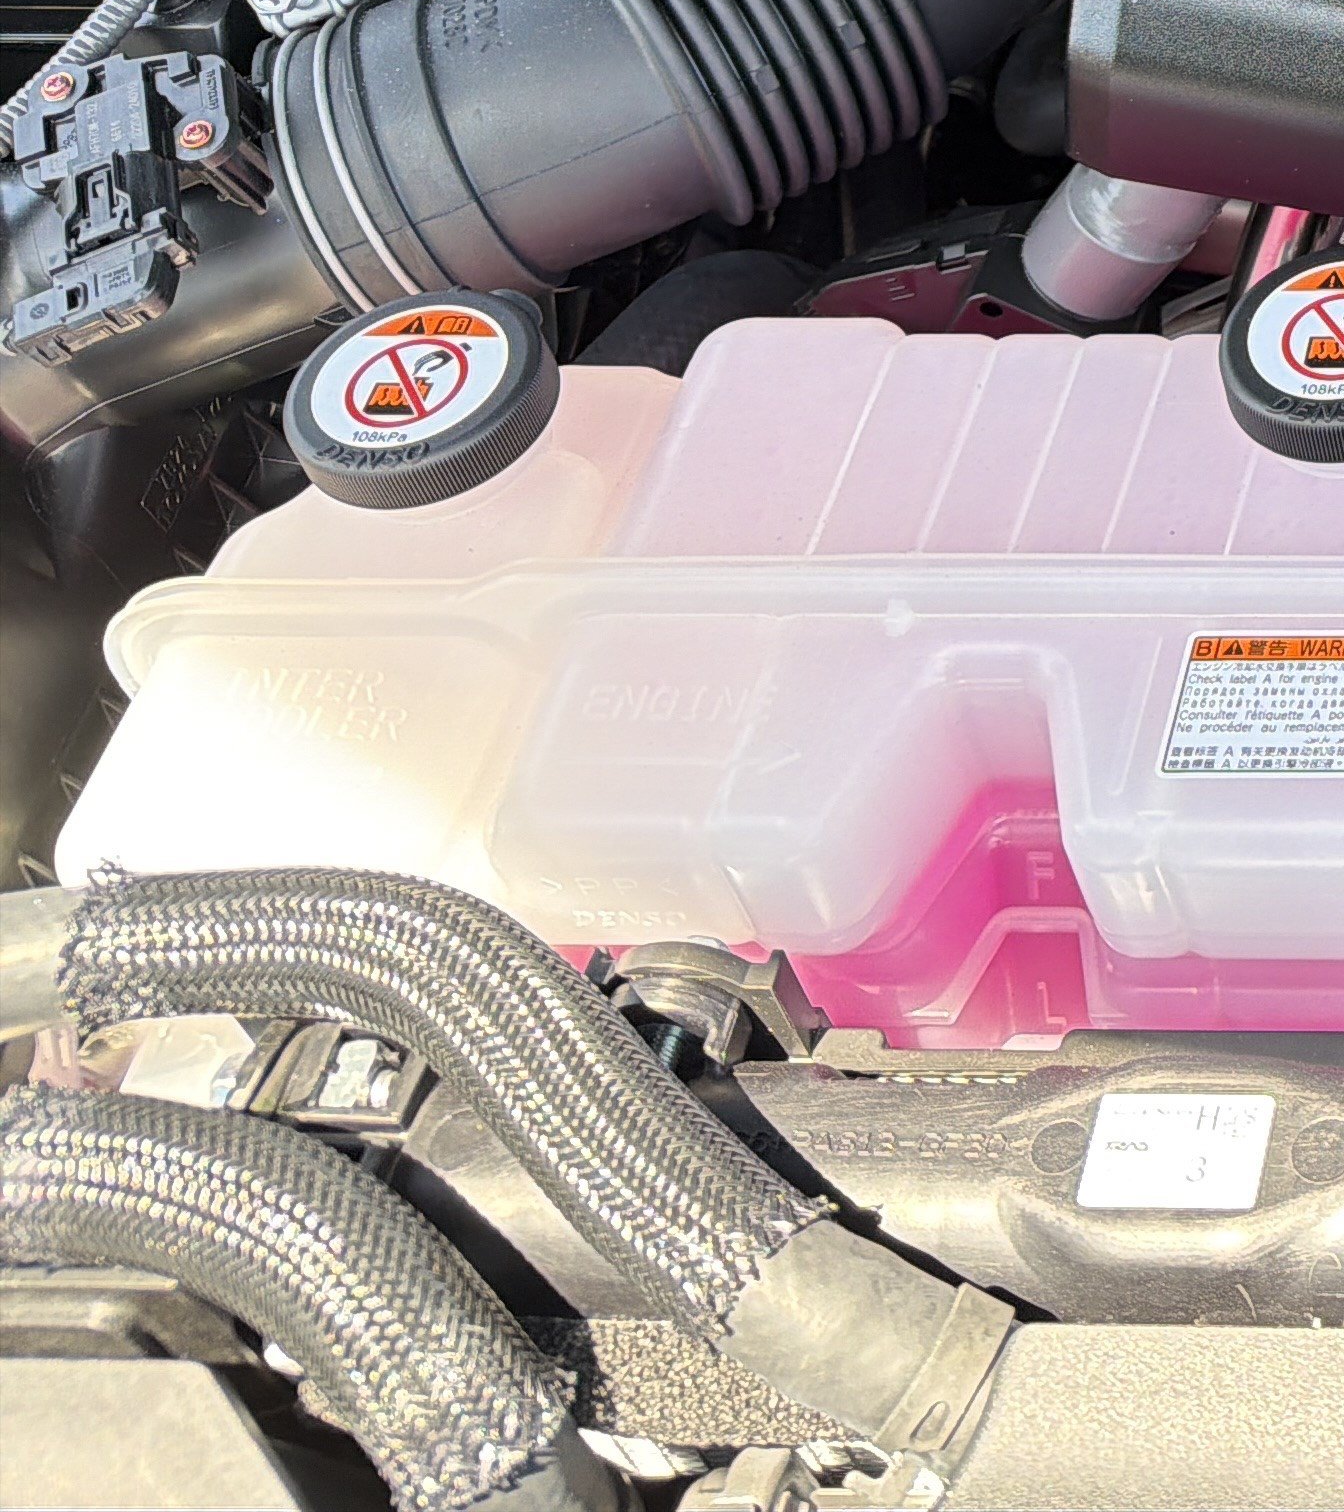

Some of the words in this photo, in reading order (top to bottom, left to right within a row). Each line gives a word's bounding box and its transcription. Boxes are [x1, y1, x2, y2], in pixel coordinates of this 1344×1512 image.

[352, 430, 408, 443] 108kPa
[1195, 640, 1213, 656] B
[226, 666, 384, 704] INTER
[1189, 674, 1222, 684] Check
[1229, 674, 1257, 684] label
[1279, 674, 1295, 684] for
[1301, 674, 1338, 686] engine
[581, 683, 778, 723] ENGINE
